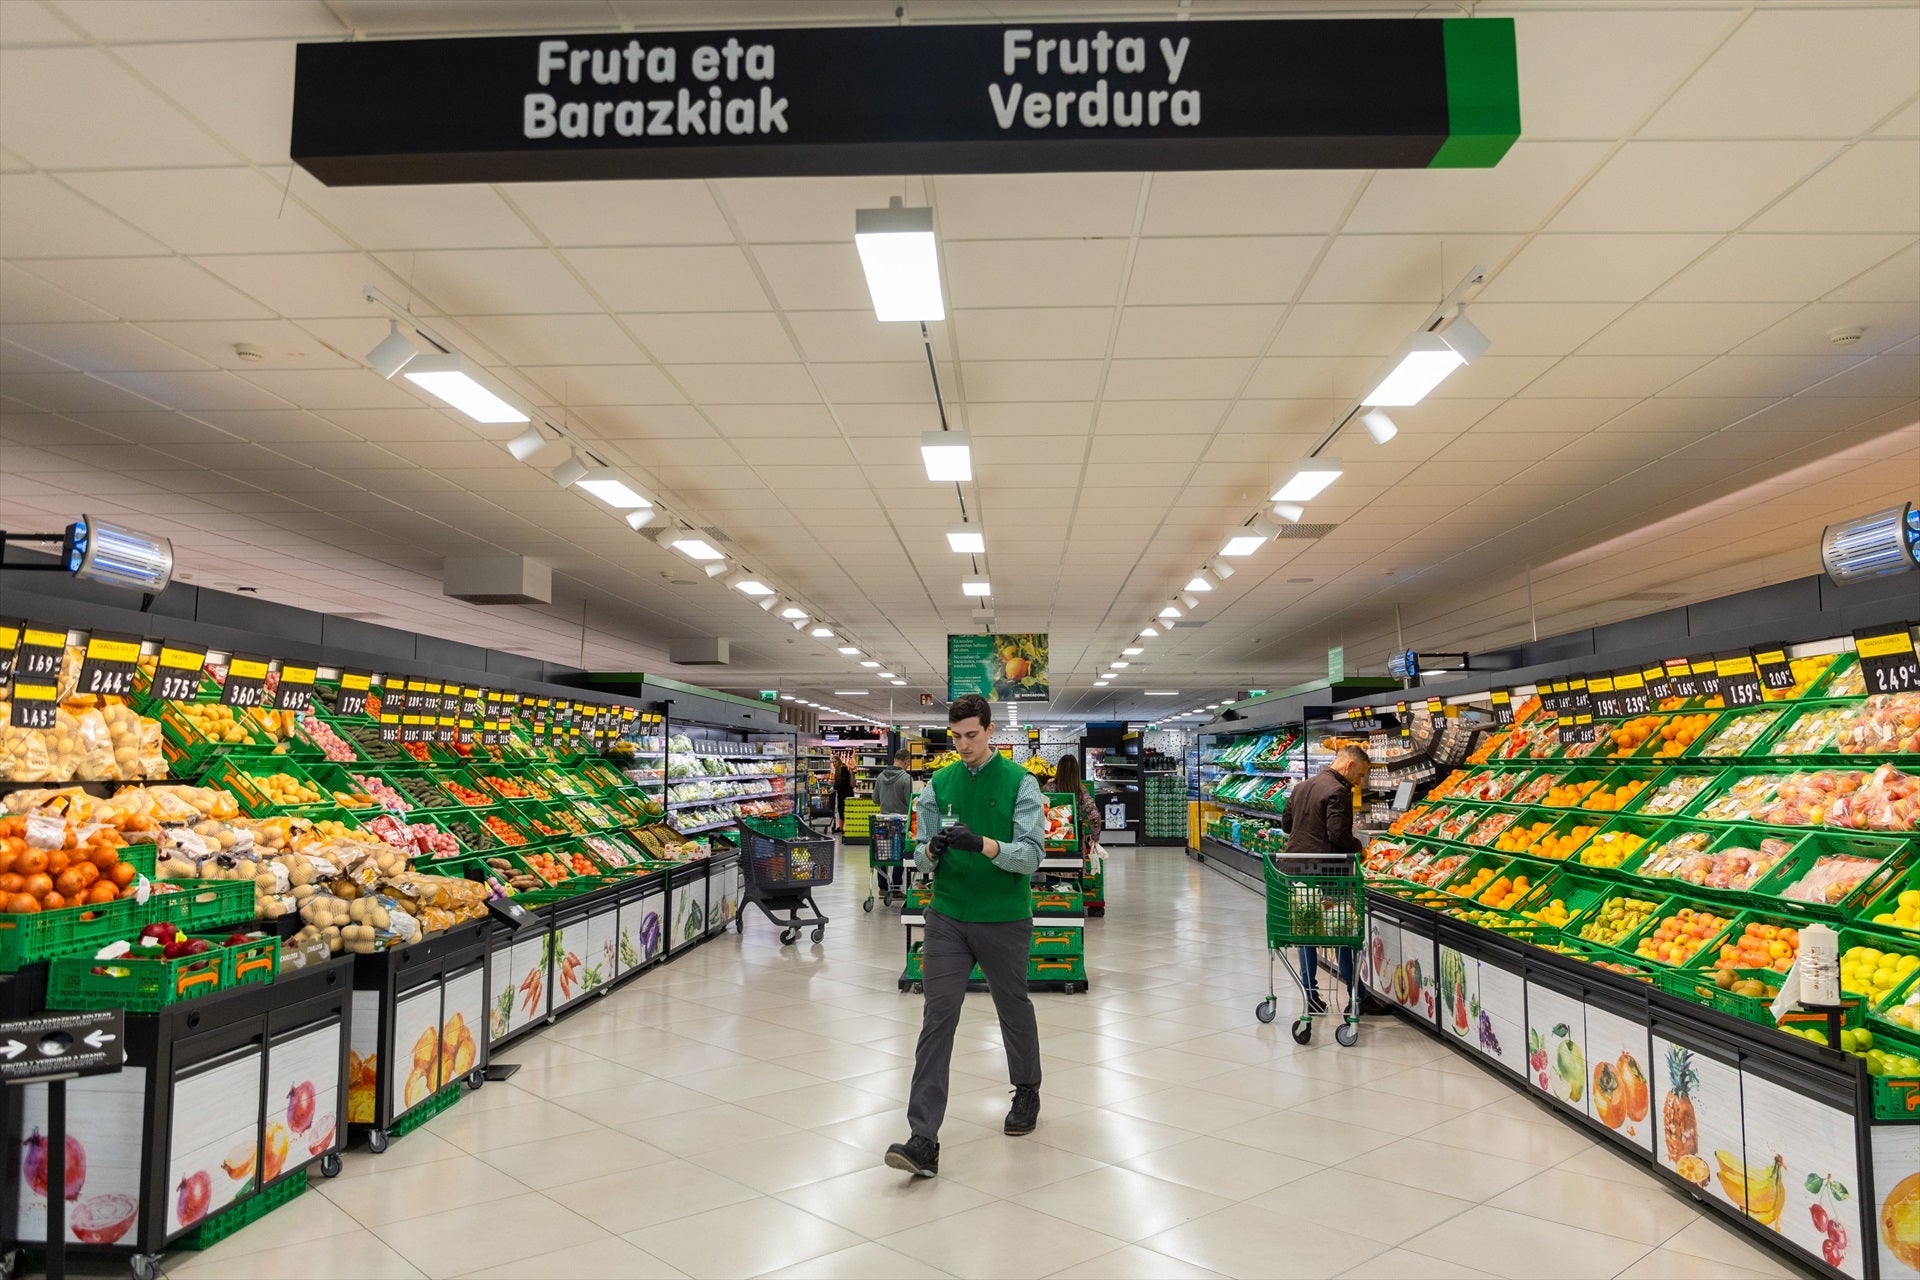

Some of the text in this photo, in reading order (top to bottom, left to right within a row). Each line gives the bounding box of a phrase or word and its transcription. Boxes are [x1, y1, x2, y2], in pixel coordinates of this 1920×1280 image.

[537, 37, 775, 86] Fruta eta
[1003, 29, 1190, 84] Fruta y
[523, 85, 789, 139] Barazkiak
[987, 78, 1201, 130] Verdura
